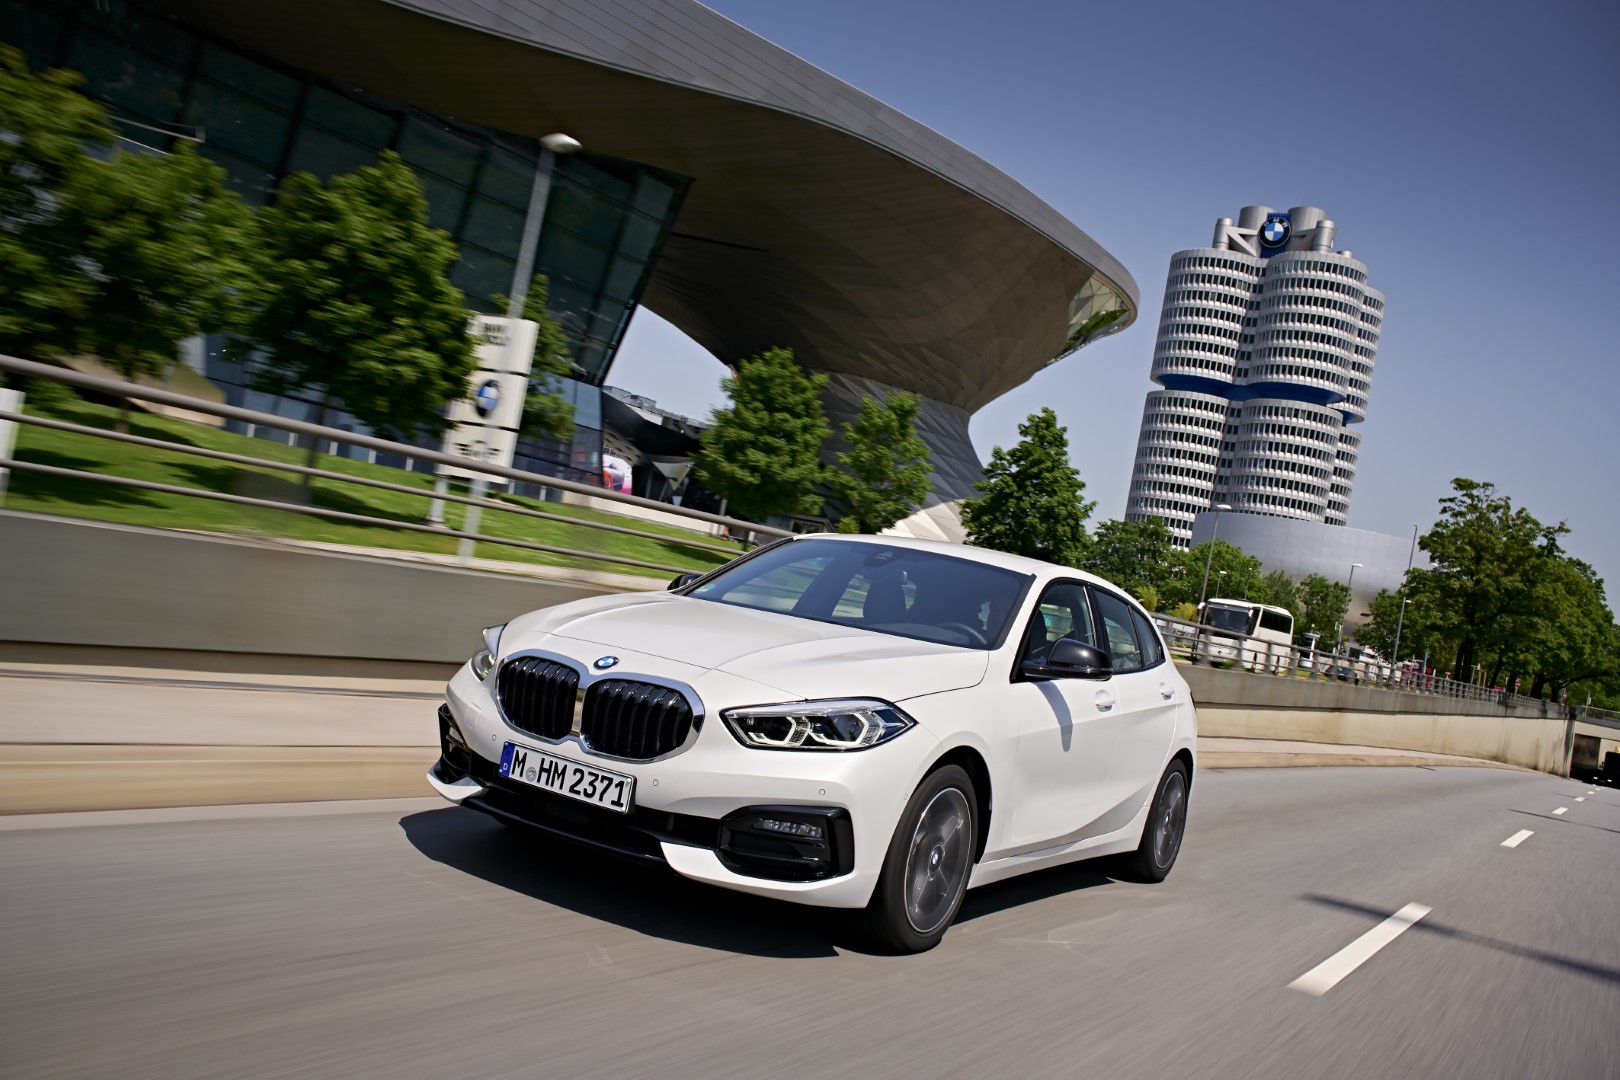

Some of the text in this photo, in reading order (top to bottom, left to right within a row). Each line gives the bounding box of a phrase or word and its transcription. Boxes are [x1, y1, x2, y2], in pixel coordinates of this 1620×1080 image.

[511, 749, 625, 808] M HM 2371
